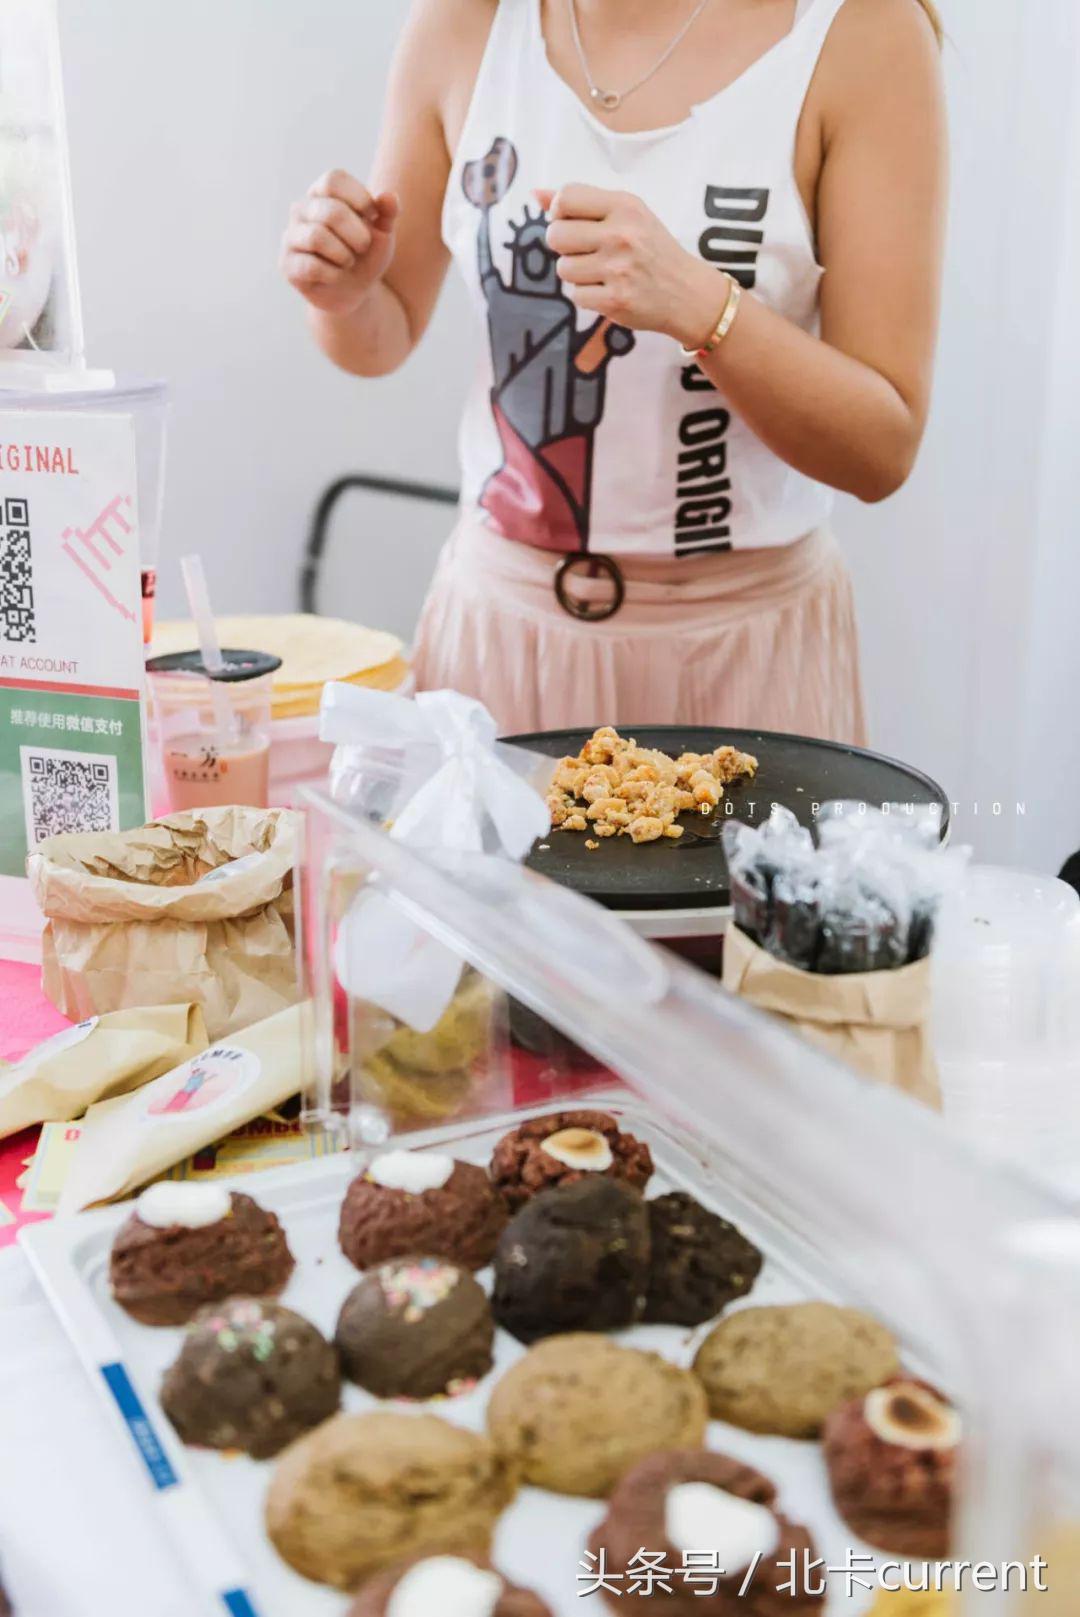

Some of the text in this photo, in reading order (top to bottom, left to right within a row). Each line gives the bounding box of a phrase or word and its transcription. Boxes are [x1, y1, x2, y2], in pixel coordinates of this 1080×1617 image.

[20, 656, 81, 674] ACCOUNT
[10, 708, 123, 737] 推荐使用微信支付
